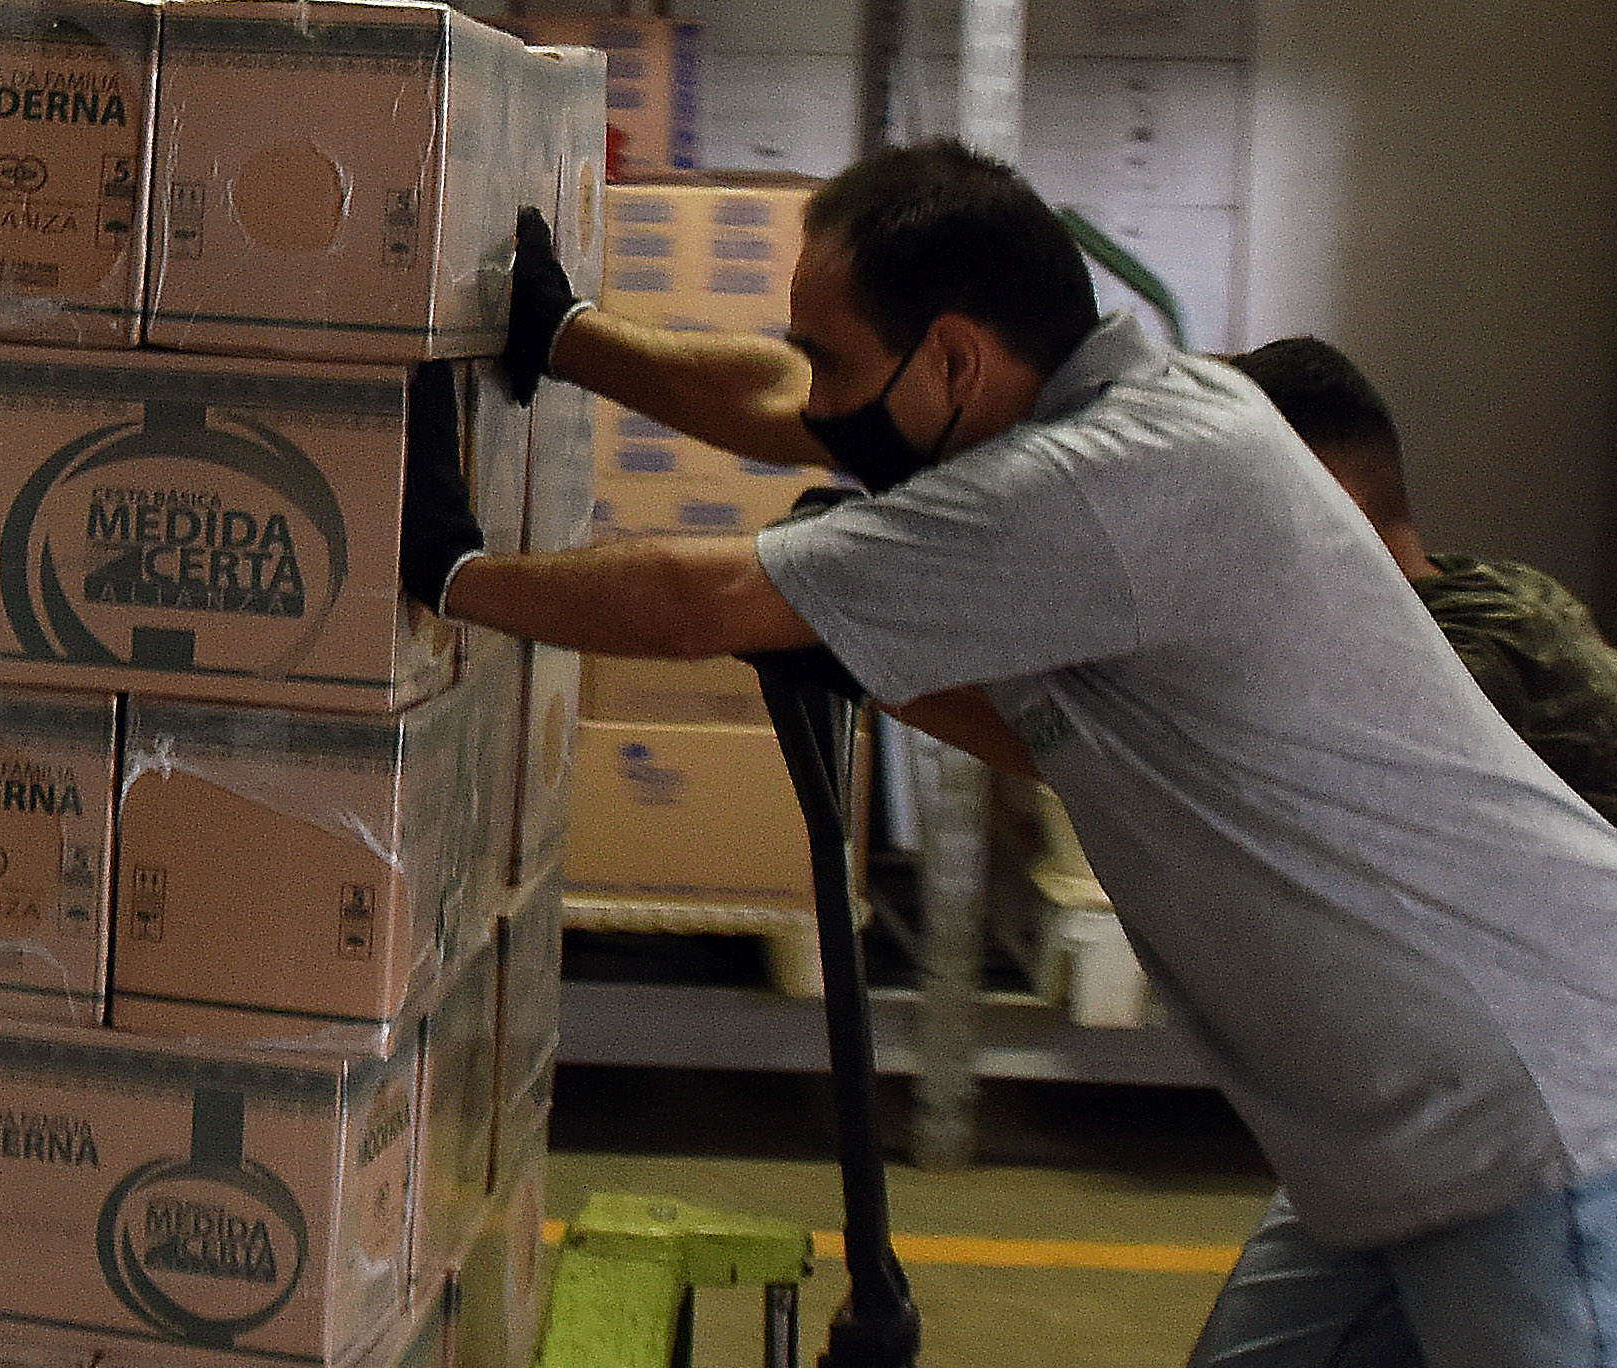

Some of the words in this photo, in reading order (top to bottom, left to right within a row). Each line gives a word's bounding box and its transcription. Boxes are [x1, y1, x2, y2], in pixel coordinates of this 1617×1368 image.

[87, 502, 292, 552] MEDIDA
[144, 545, 302, 593] CERTA
[100, 580, 286, 617] ALIANZA
[146, 1205, 269, 1245] MEDIDA
